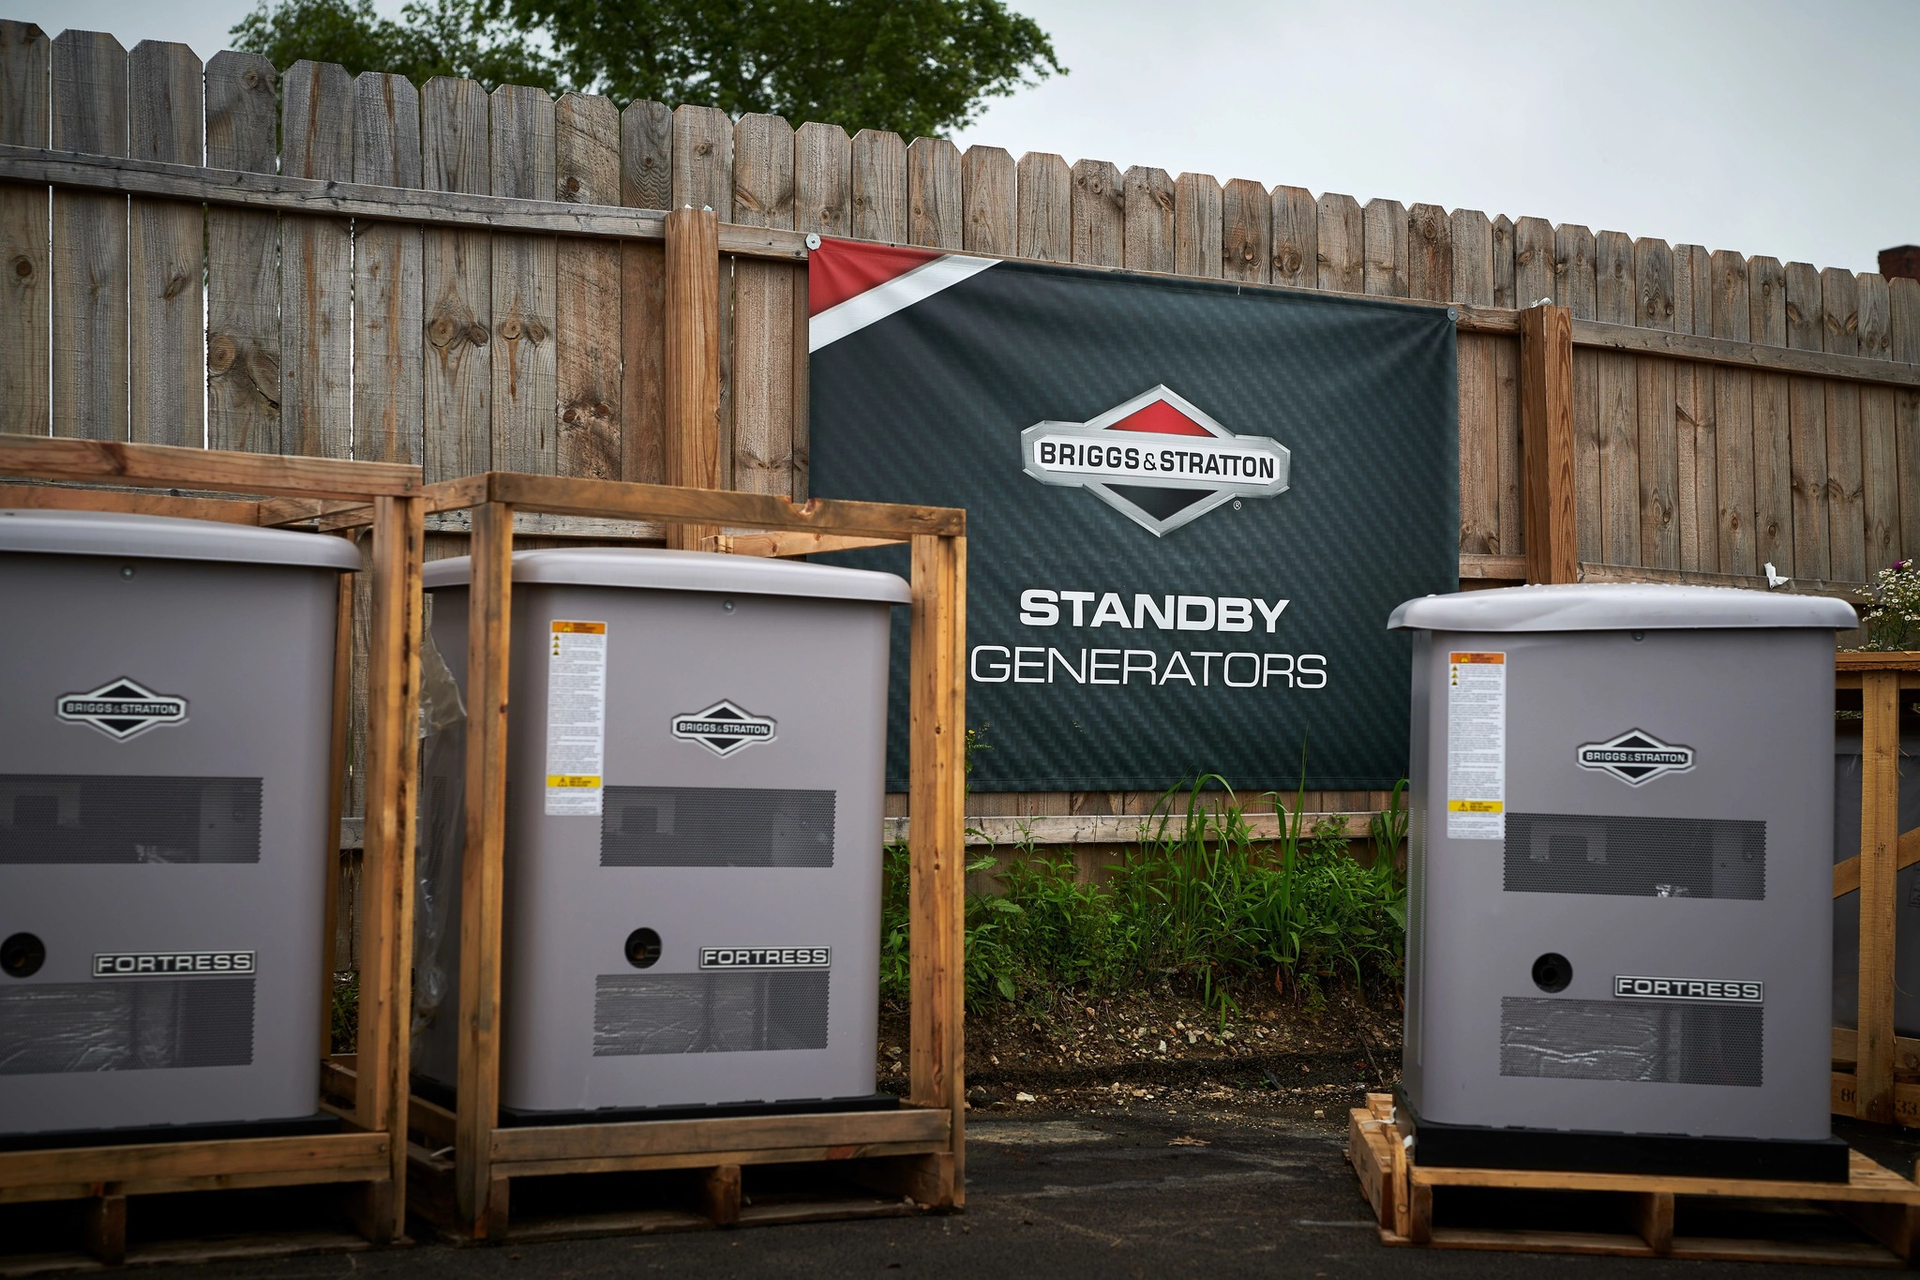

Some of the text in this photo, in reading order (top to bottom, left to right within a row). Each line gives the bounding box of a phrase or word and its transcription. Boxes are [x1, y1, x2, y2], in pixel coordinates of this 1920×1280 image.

[1019, 588, 1291, 633] STANDBY
[970, 644, 1328, 689] GENERATORS
[97, 954, 251, 972] FORTRESS
[703, 949, 828, 965] FORTRESS
[1618, 979, 1760, 998] FORTRESS
